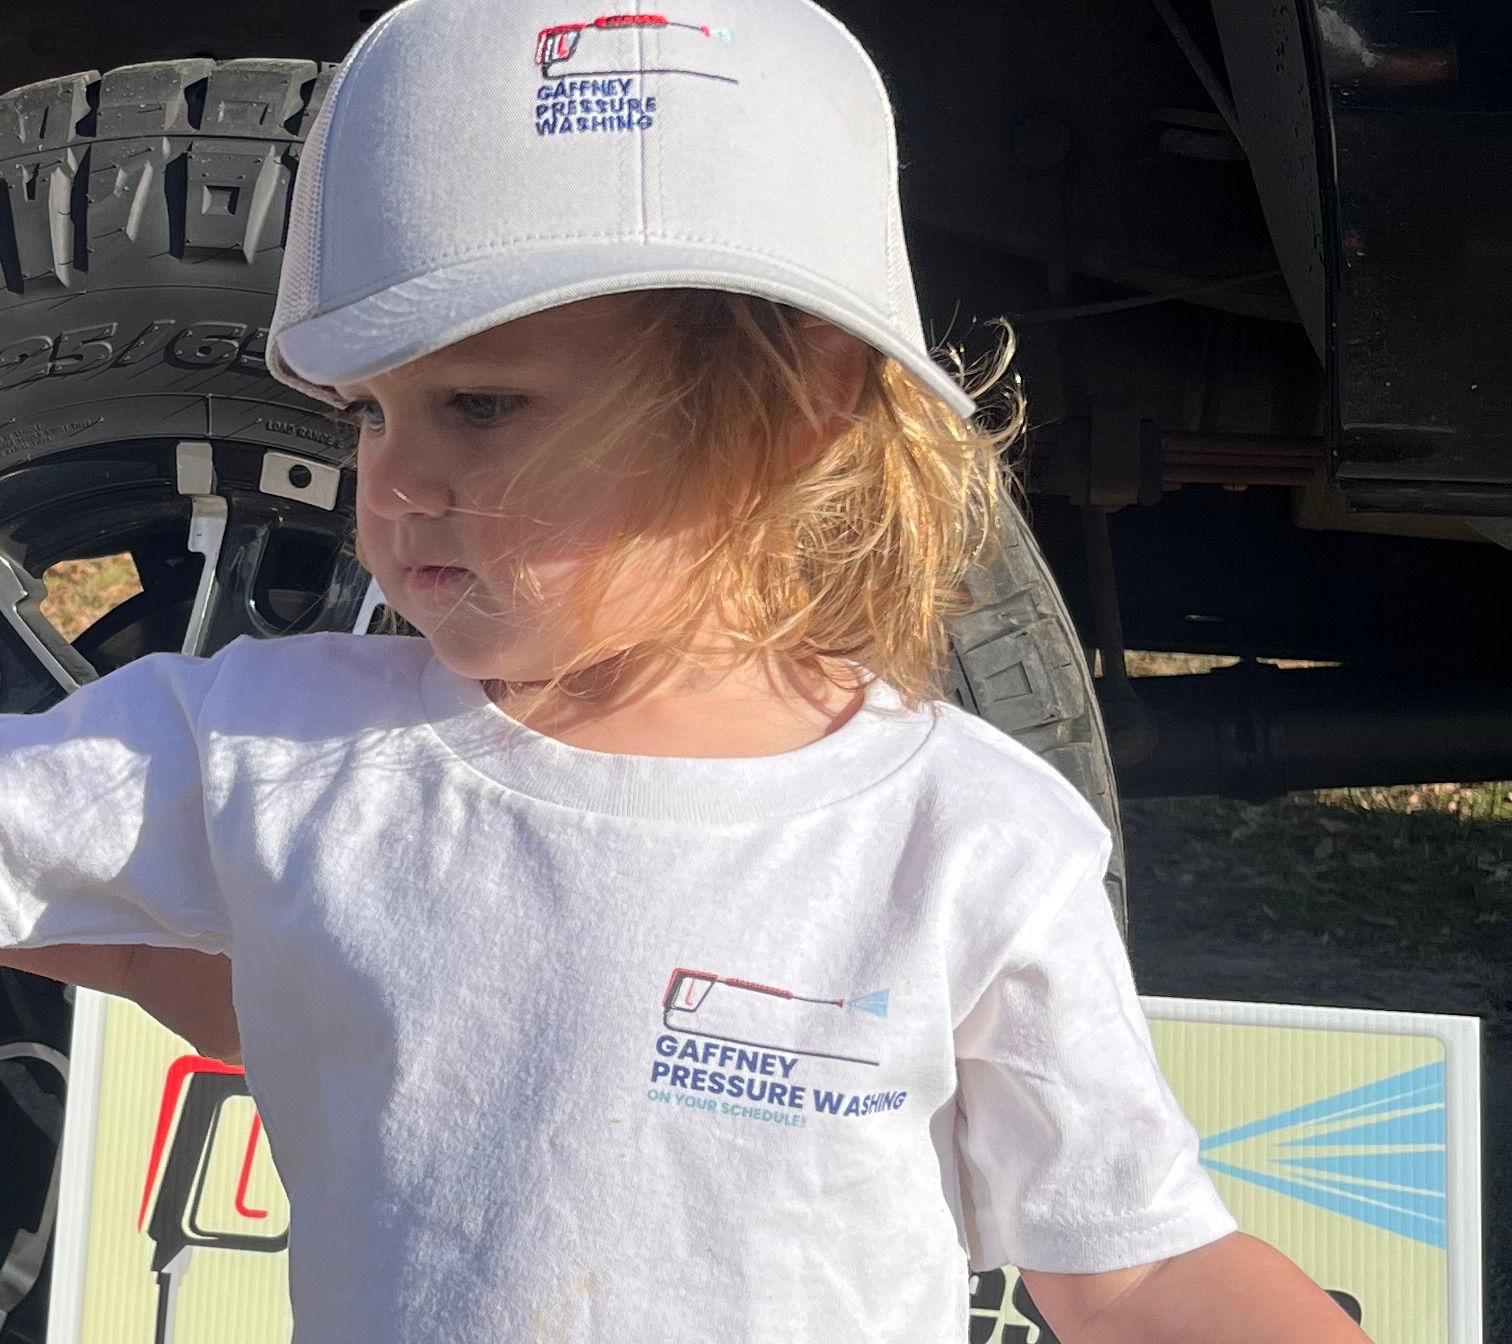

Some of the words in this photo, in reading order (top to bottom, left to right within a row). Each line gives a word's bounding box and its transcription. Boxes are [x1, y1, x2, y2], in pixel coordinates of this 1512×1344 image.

[537, 78, 632, 100] GAFFNEY
[535, 98, 656, 118] PRESSURE
[535, 116, 653, 135] WASHING
[656, 1034, 799, 1079] GAFFNEY
[650, 1060, 806, 1109] PRESSURE
[812, 1090, 908, 1117] WASHING
[647, 1089, 671, 1102] ON
[675, 1094, 718, 1113] YOUR
[721, 1101, 807, 1129] SCHEDULE!
